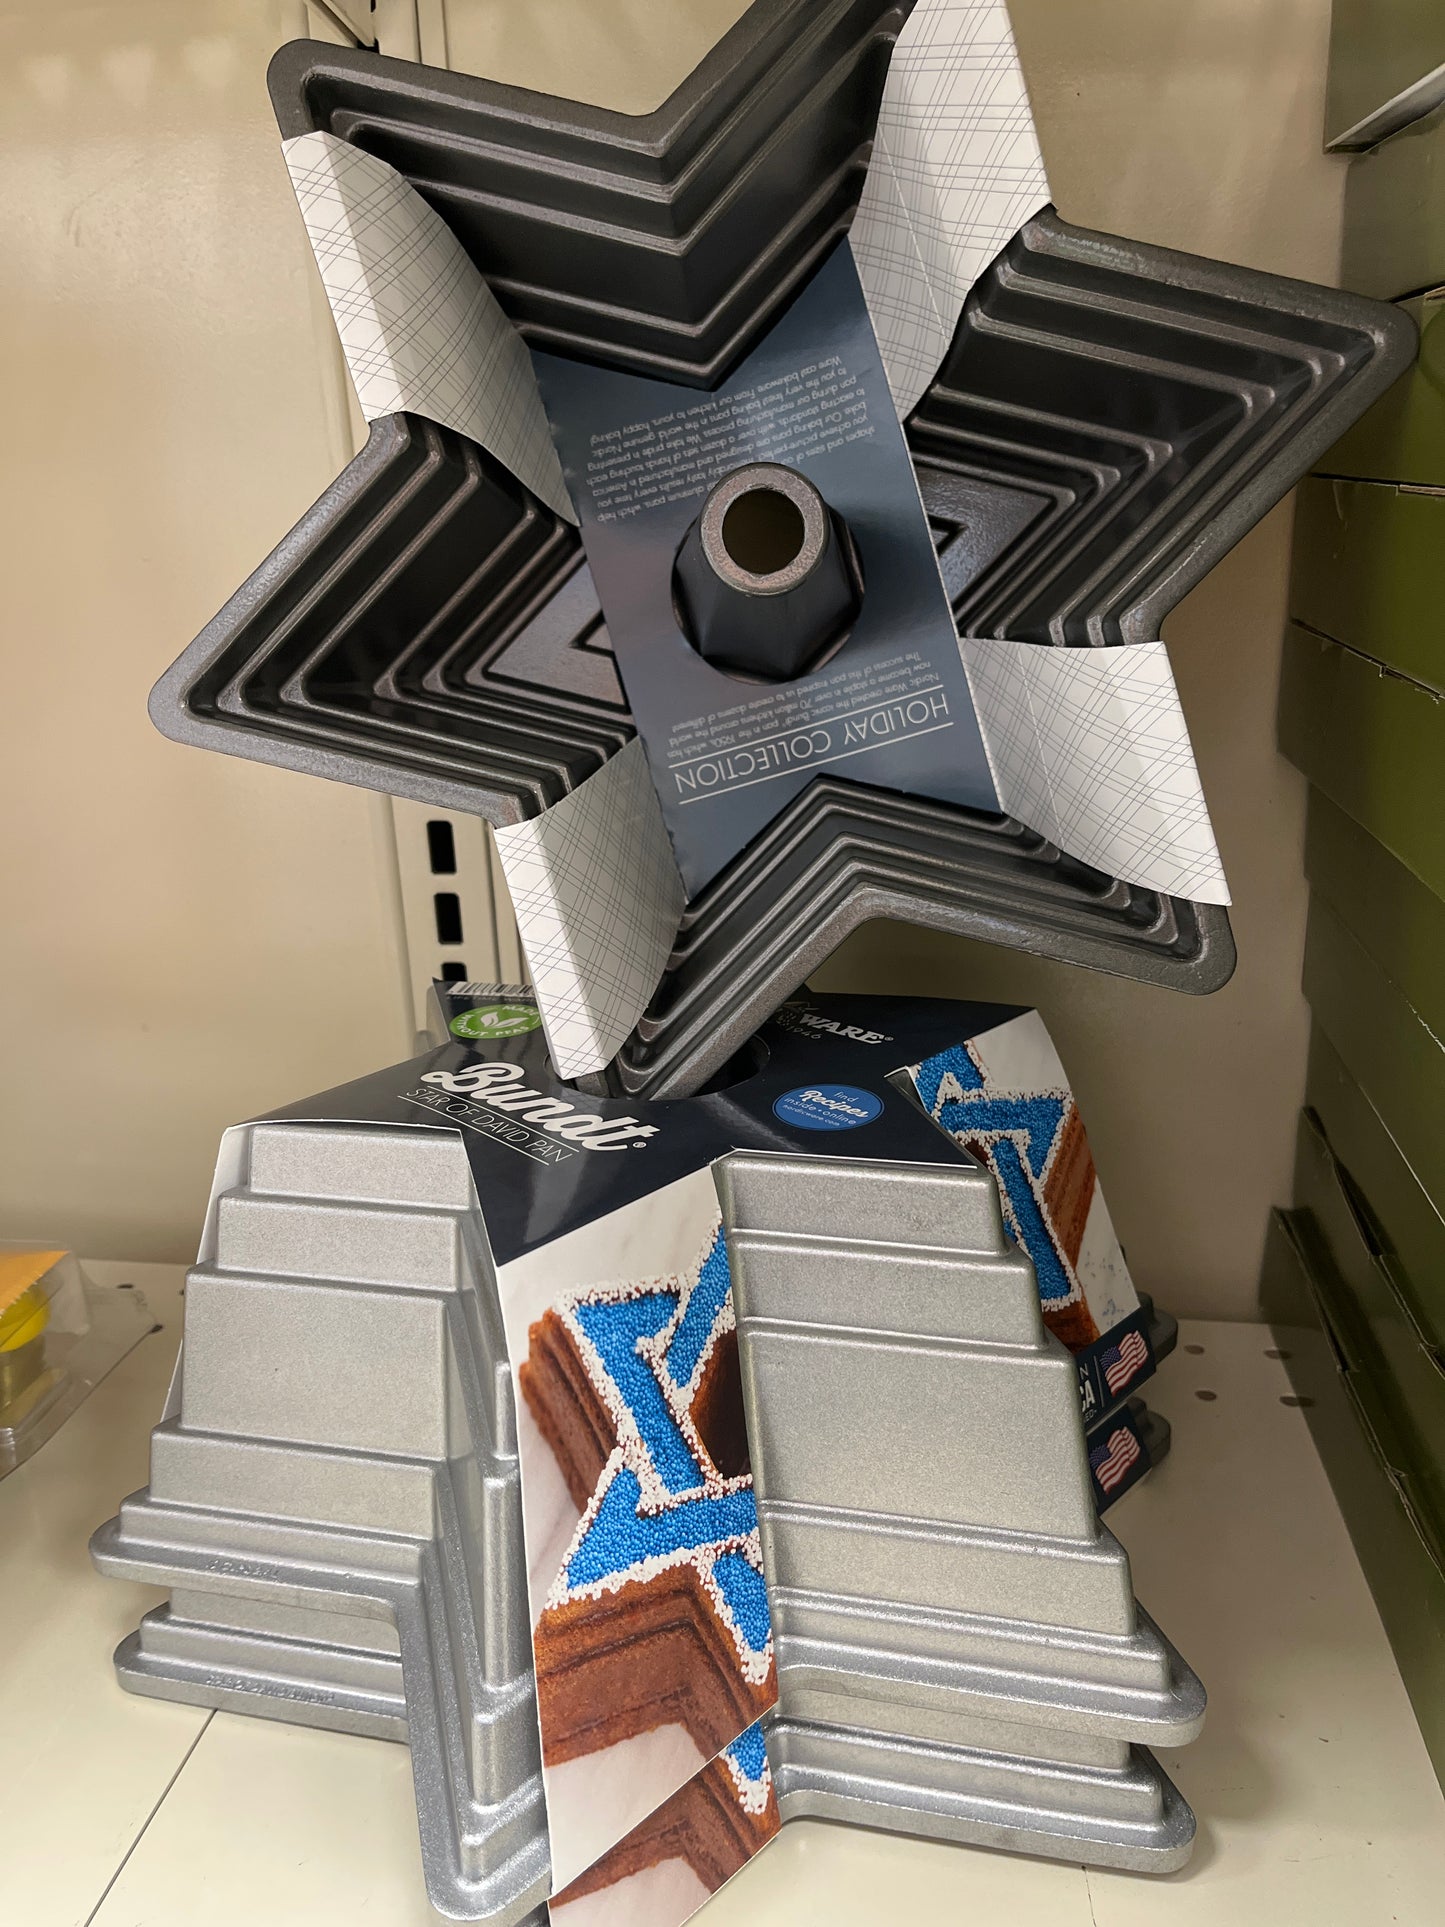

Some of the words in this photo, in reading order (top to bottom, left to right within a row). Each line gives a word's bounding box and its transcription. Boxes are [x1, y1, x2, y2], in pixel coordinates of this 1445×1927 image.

[817, 355, 841, 370] Ware
[799, 364, 817, 377] cast
[819, 369, 836, 382] you
[836, 366, 847, 376] to
[804, 378, 820, 390] the
[838, 375, 857, 388] pan
[733, 388, 755, 402] From
[784, 383, 804, 395] very
[810, 383, 838, 400] during
[855, 387, 865, 396] to
[718, 396, 732, 405] our
[761, 392, 784, 406] finest
[796, 395, 810, 405] our
[819, 391, 855, 410] exacting
[686, 401, 717, 417] kitchen
[730, 399, 761, 416] baking
[735, 400, 795, 428] manufacturing
[675, 411, 686, 419] to
[708, 408, 730, 422] pans
[823, 411, 842, 424] Our
[851, 412, 868, 425] you
[621, 420, 650, 436] happy
[684, 420, 699, 431] the
[756, 422, 775, 435] with
[792, 417, 823, 434] baking
[818, 421, 852, 439] achieve
[588, 428, 622, 447] baking!
[621, 431, 655, 448] genuine
[685, 433, 701, 445] We
[727, 435, 735, 443] a
[736, 428, 756, 440] over
[770, 427, 793, 441] pans
[844, 424, 875, 443] shapes
[665, 438, 685, 450] take
[699, 438, 727, 453] dozen
[755, 437, 770, 447] are
[825, 437, 844, 453] and
[591, 443, 622, 459] Nordic
[631, 451, 640, 459] in
[641, 442, 665, 458] pride
[682, 446, 699, 457] sets
[714, 442, 754, 464] designed
[804, 443, 826, 457] sizes
[586, 450, 631, 472] presenting
[644, 455, 672, 471] hands
[672, 452, 682, 464] of
[695, 455, 714, 469] and
[795, 452, 805, 464] of
[608, 462, 644, 480] touching
[637, 460, 696, 487] manufactured
[707, 455, 754, 478] memorably
[585, 473, 609, 487] each
[628, 478, 637, 486] in
[686, 470, 706, 483] tasty
[591, 481, 628, 498] America
[633, 484, 658, 498] every
[658, 477, 685, 493] results
[613, 493, 632, 504] time
[666, 484, 705, 503] aluminum
[596, 497, 612, 508] you
[596, 510, 617, 523] help
[616, 503, 641, 519] which
[872, 655, 903, 671] success
[904, 650, 921, 662] The
[863, 665, 872, 677] of
[912, 660, 931, 671] now
[828, 672, 846, 684] pan
[847, 669, 862, 680] this
[868, 677, 876, 685] a
[877, 666, 912, 683] become
[908, 671, 939, 688] Nordic
[784, 689, 795, 697] us
[795, 679, 828, 697] inspired
[833, 688, 841, 696] in
[842, 680, 868, 695] staple
[884, 681, 908, 694] Ware
[747, 695, 774, 709] create
[775, 693, 785, 701] to
[798, 697, 813, 710] 70
[814, 691, 833, 702] over
[850, 689, 883, 707] created
[716, 703, 747, 719] dozens
[773, 702, 798, 715] million
[810, 703, 834, 717] iconic
[835, 699, 850, 710] the
[706, 713, 716, 725] of
[739, 709, 774, 725] kitchens
[761, 718, 779, 730] pan
[841, 692, 949, 745] HOLIDAY
[671, 715, 706, 734] different
[708, 719, 739, 736] around
[752, 725, 760, 733] in
[694, 729, 709, 738] the
[737, 729, 752, 739] the
[666, 749, 683, 759] has
[683, 741, 707, 756] which
[673, 728, 832, 794] COLLECTION
[502, 1005, 539, 1016] MADE
[456, 1014, 488, 1036] WITHOUT
[495, 1026, 529, 1036] PFAS
[786, 1026, 821, 1039] 1946
[833, 1091, 859, 1102] find
[799, 1090, 869, 1118] Recipes
[784, 1098, 817, 1111] inside
[822, 1110, 857, 1125] online
[406, 1088, 443, 1106] STAR
[445, 1103, 480, 1121] OF
[472, 1114, 530, 1142] DAVID
[532, 1139, 573, 1163] PAN
